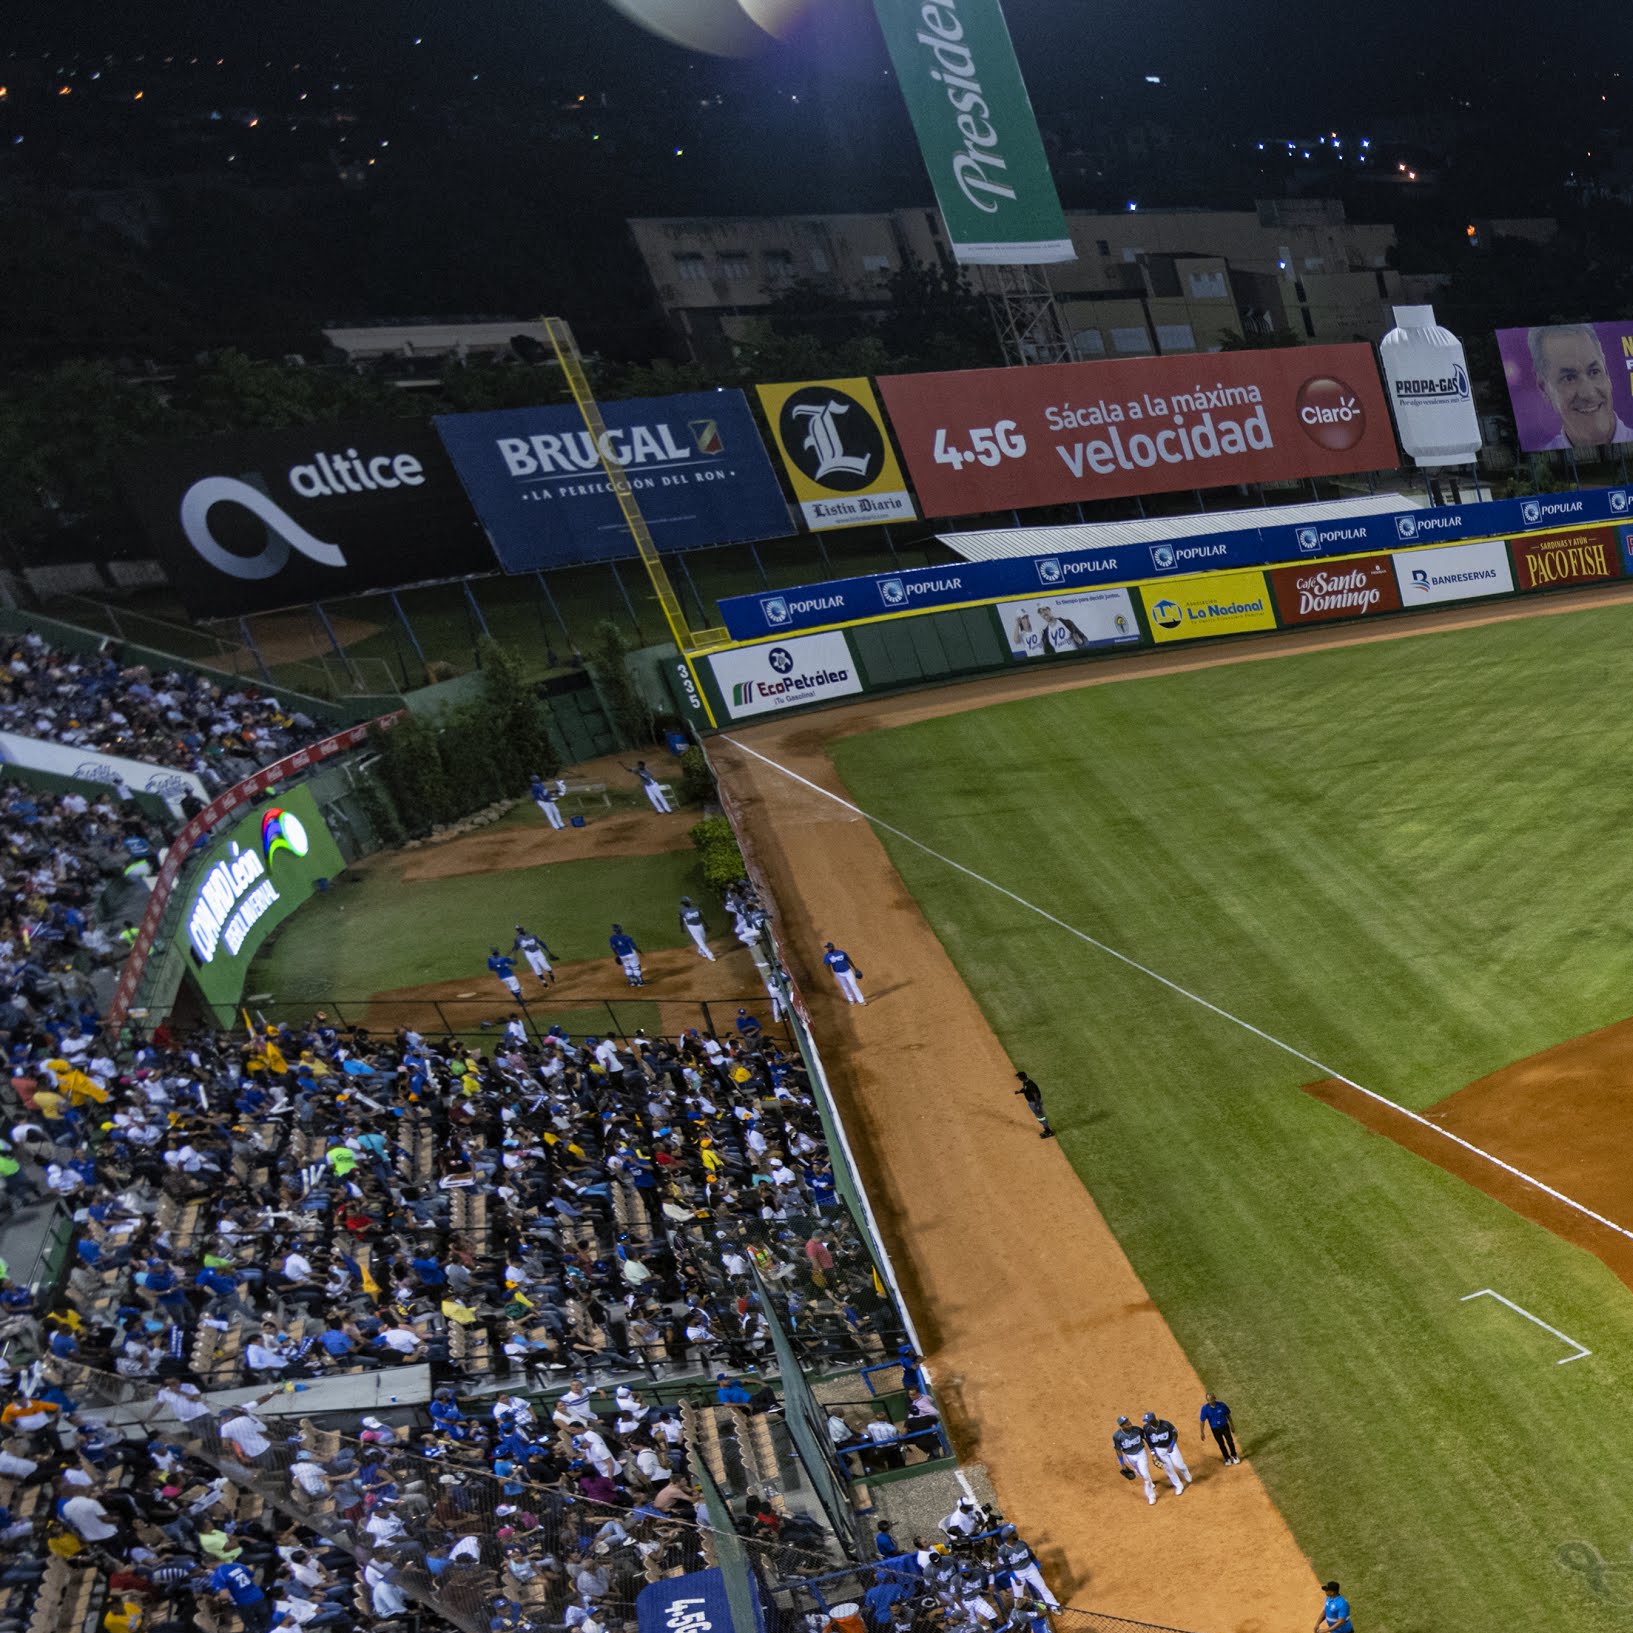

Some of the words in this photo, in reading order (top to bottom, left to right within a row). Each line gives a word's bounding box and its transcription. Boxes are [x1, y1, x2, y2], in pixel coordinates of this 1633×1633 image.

[1396, 377, 1459, 397] PROPA-GAS
[1044, 402, 1125, 433] Sácala
[1128, 404, 1145, 420] a
[1147, 392, 1168, 418] la
[1170, 381, 1263, 414] máxima
[1301, 403, 1355, 426] Claro
[496, 424, 691, 476] BRUGAL
[933, 418, 1028, 472] 4.5G
[1055, 404, 1274, 479] velocidad
[288, 447, 426, 499] altice
[531, 490, 553, 502] LA
[662, 473, 689, 486] DEL
[695, 469, 726, 482] RON
[858, 496, 904, 513] Diario
[1541, 501, 1583, 515] POPULAR
[1319, 527, 1368, 543] POPULAR
[1417, 516, 1462, 531] POPULAR
[1176, 544, 1227, 561] POPULAR
[1063, 558, 1118, 575] POPULAR
[1431, 568, 1497, 586] BANRESERVAS
[1525, 551, 1569, 588] PACO
[1565, 545, 1610, 580] FISH
[906, 578, 962, 595] POPULAR
[1295, 577, 1316, 591] Café
[1315, 568, 1368, 594] Santo
[789, 595, 845, 614] POPULAR
[1188, 607, 1207, 621] La
[1209, 599, 1264, 618] Nacional
[1300, 587, 1381, 616] Domingo
[677, 664, 700, 709] 335
[756, 668, 849, 698] EcoPetróleo
